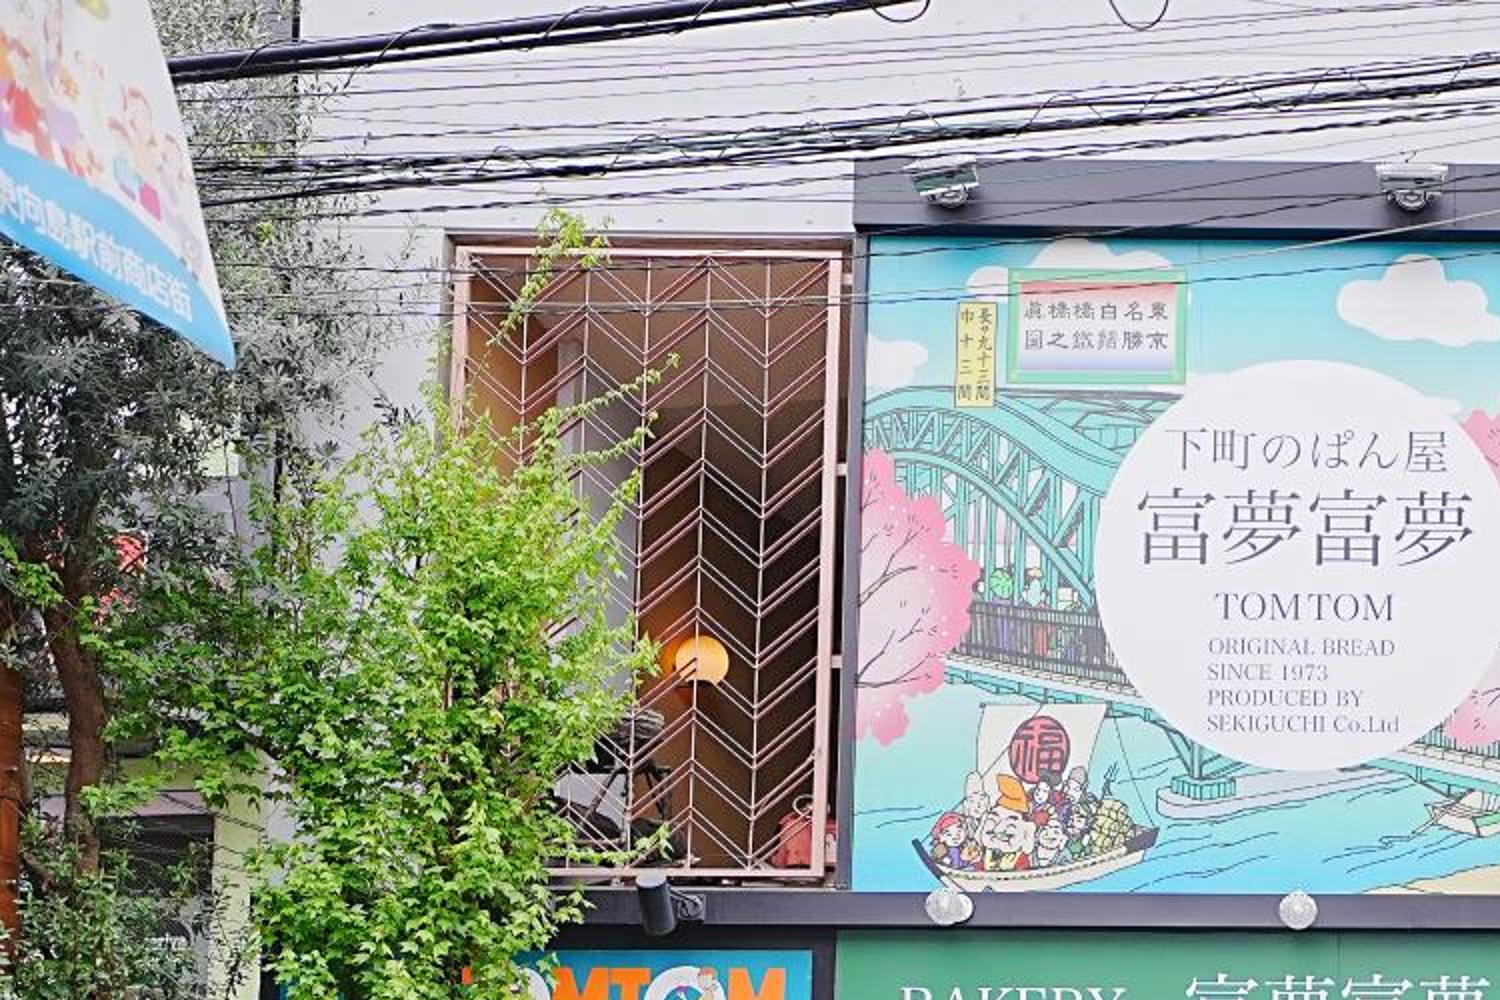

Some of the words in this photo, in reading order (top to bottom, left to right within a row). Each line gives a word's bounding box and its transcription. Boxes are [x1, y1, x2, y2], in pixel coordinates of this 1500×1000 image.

[1164, 428, 1448, 473] 下町のぱん屋
[1137, 487, 1473, 567] 富夢富夢
[1208, 638, 1316, 657] ORIGINAL
[1323, 638, 1395, 657] BREAD
[1207, 663, 1272, 681] SINCE
[1280, 663, 1329, 681] 1973
[1207, 689, 1329, 707] PRODUCED
[1336, 689, 1364, 707] BY
[1206, 715, 1326, 734] SEKIGUCHI
[1333, 715, 1400, 733] Co.Ltd
